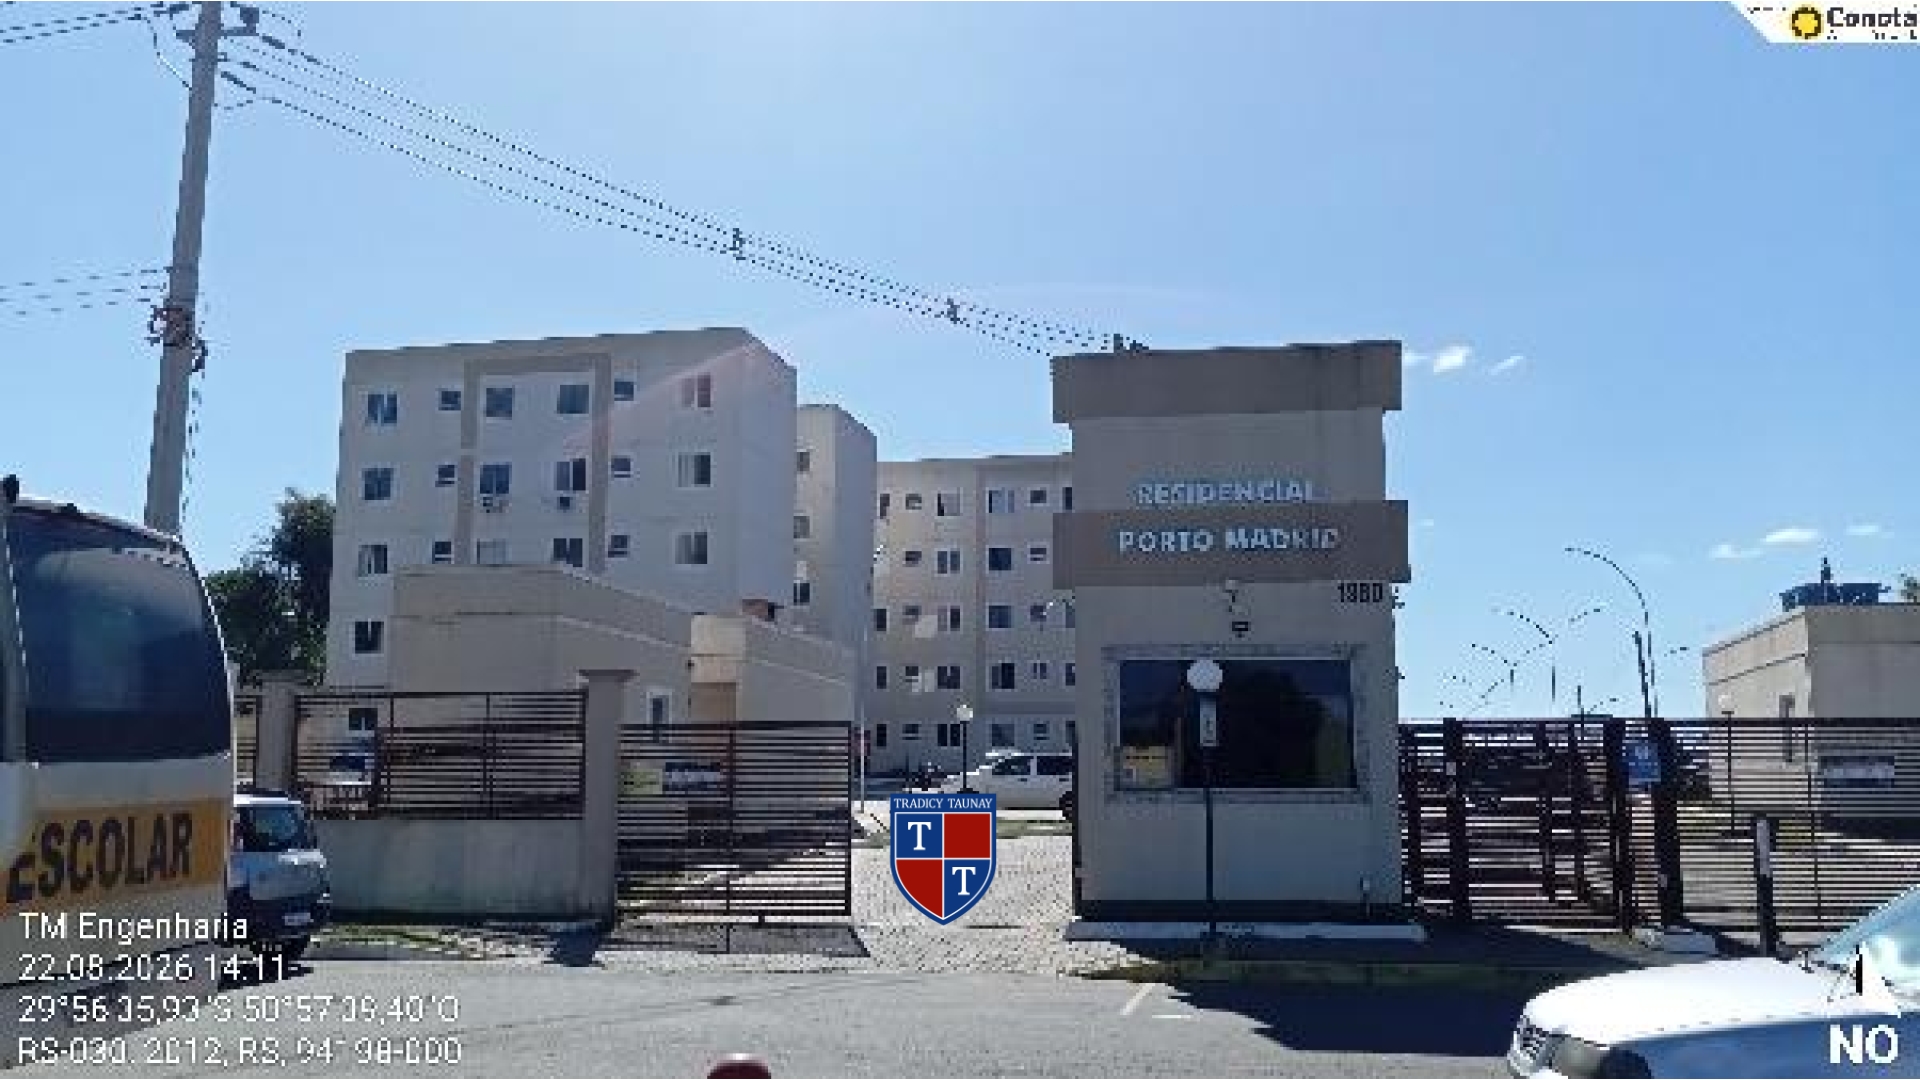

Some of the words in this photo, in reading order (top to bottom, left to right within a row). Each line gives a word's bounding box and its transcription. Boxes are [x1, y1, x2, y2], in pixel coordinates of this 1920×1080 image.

[1136, 480, 1317, 504] RESIDENCIAL
[1118, 529, 1214, 552] PORTO
[1225, 527, 1340, 550] MADRID
